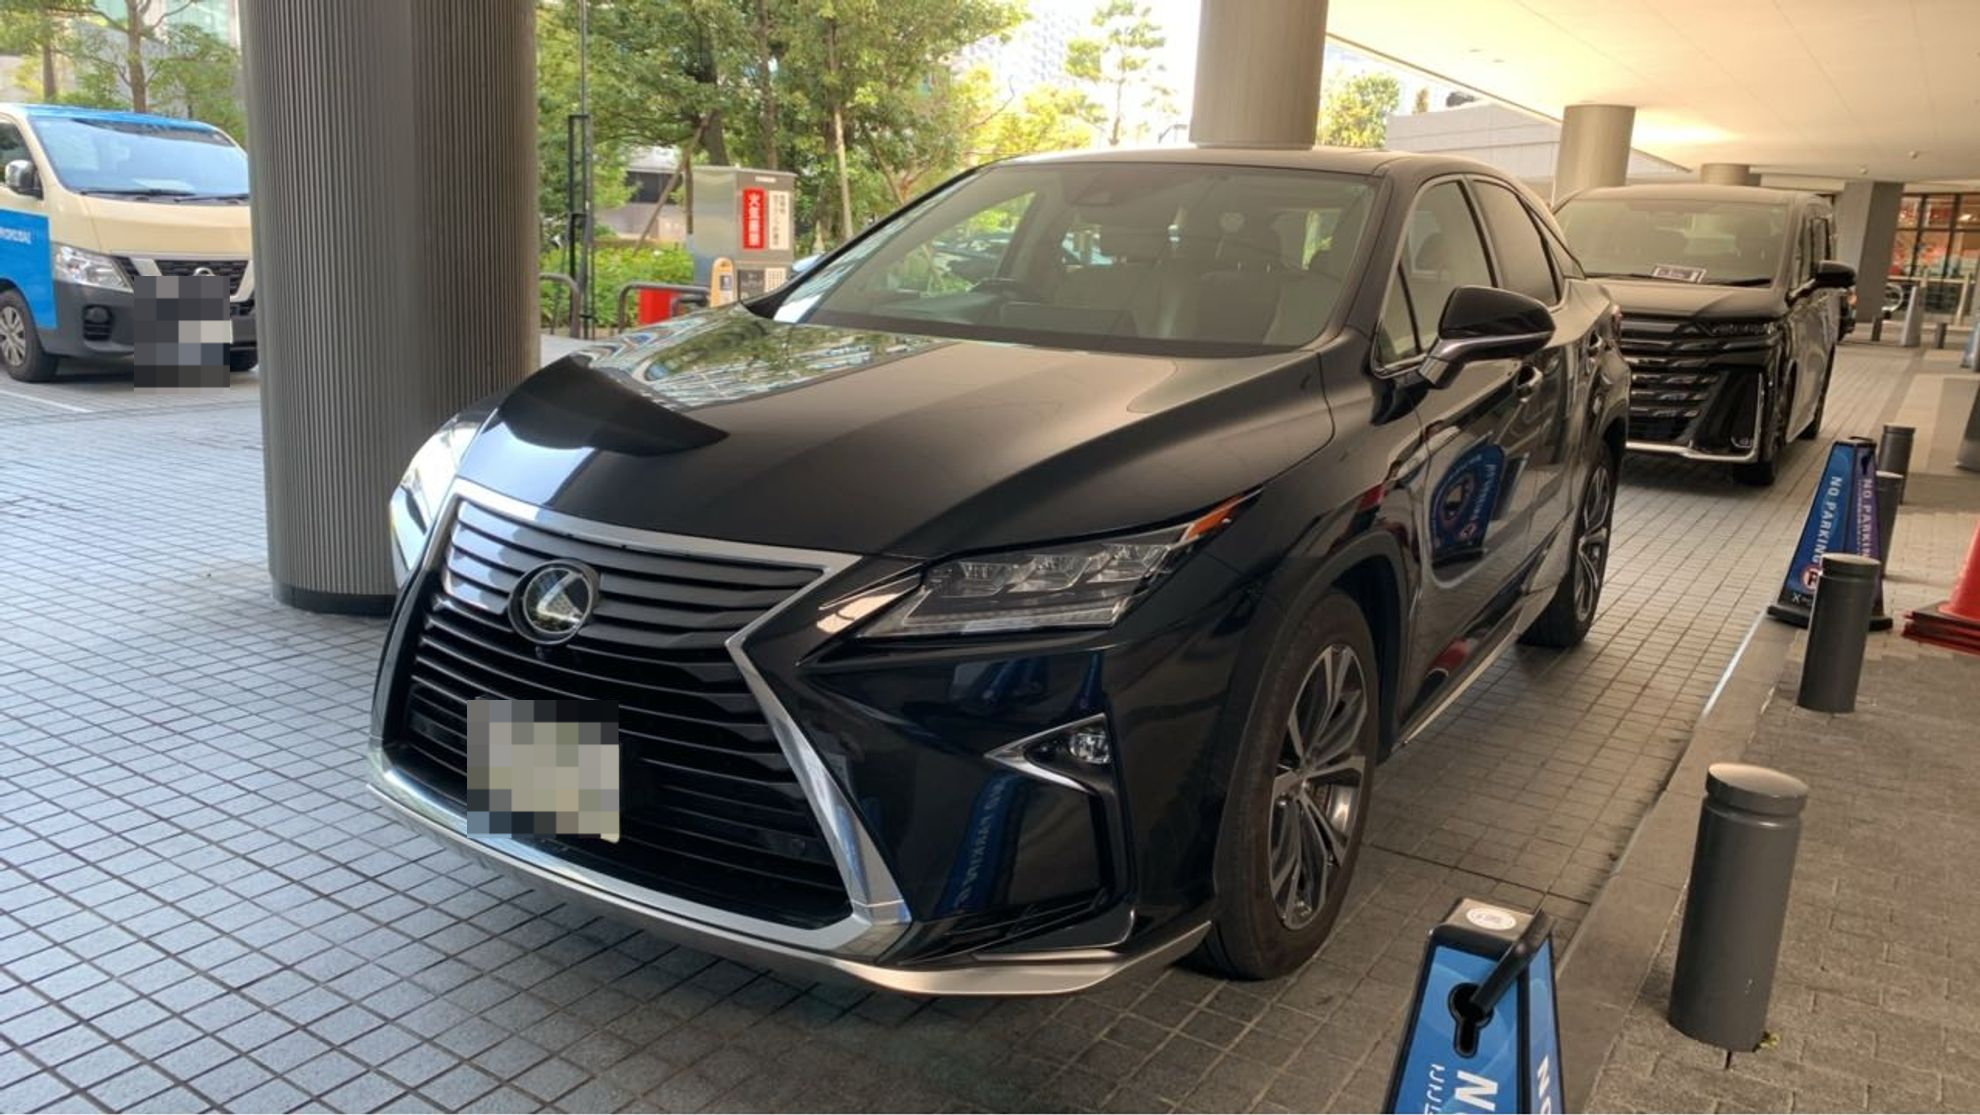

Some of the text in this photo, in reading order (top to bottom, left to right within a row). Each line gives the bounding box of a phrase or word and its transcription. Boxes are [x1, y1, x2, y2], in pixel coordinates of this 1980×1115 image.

[1812, 476, 1842, 563] NO PARKING
[1862, 479, 1873, 557] NO PARKIN
[1454, 1069, 1499, 1114] N
